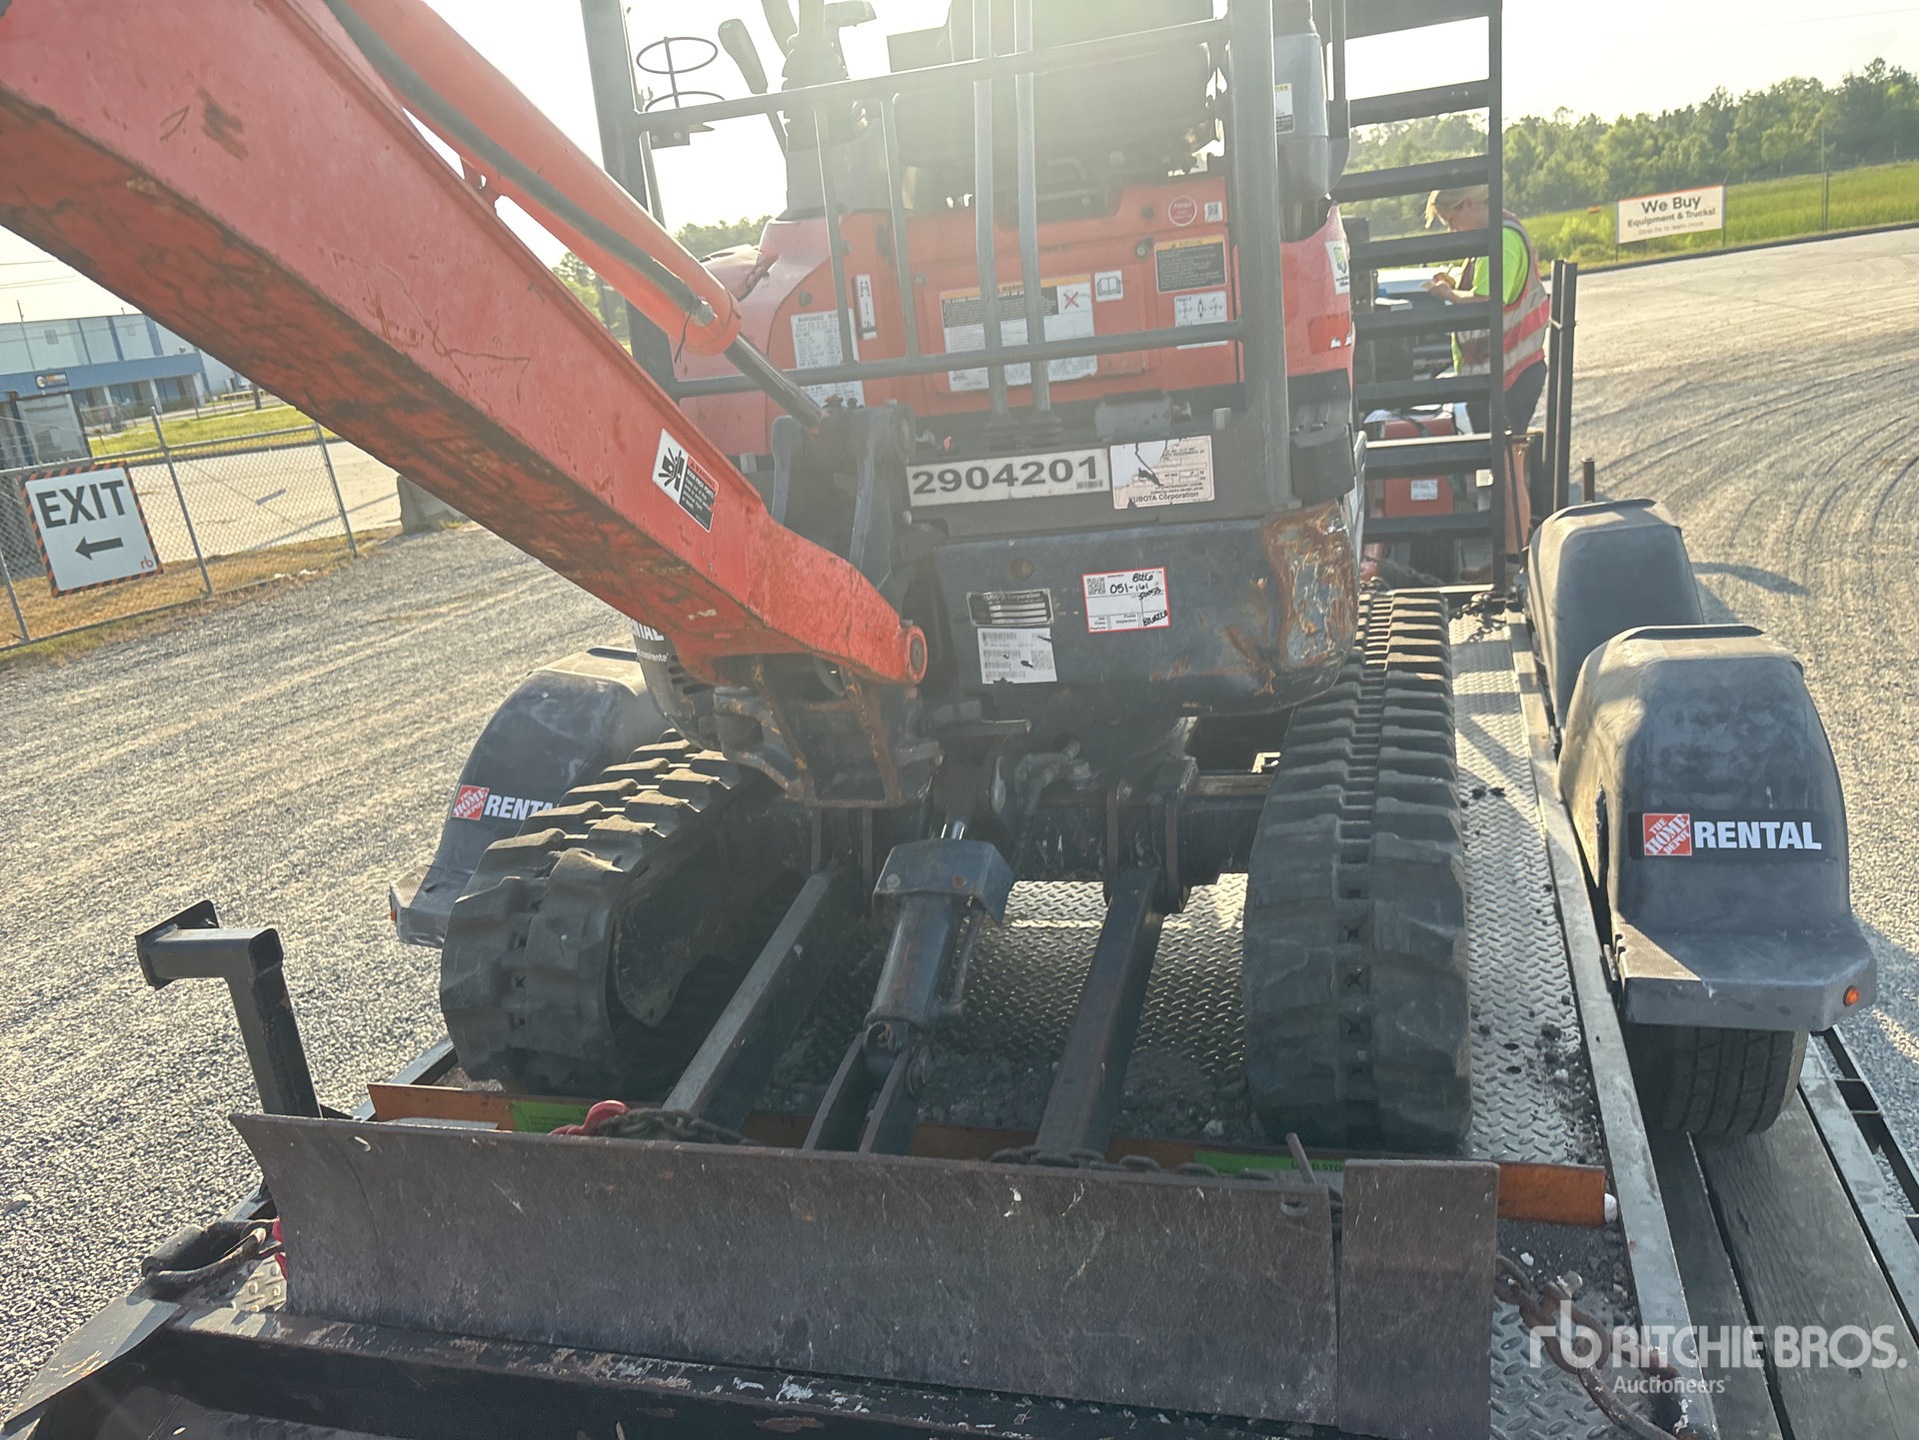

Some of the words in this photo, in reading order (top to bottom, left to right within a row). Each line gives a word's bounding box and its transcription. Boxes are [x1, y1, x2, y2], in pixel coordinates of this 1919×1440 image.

[1641, 200, 1667, 214] We
[1672, 196, 1701, 210] Buy
[1627, 213, 1675, 228] Equipment
[911, 455, 1097, 495] 2904201
[35, 479, 126, 529] EXIT
[1158, 491, 1199, 501] Corporation
[1645, 813, 1690, 856] HOME
[1648, 816, 1669, 836] THE
[1694, 821, 1822, 850] RENTAL
[1662, 829, 1691, 856] DEPOT
